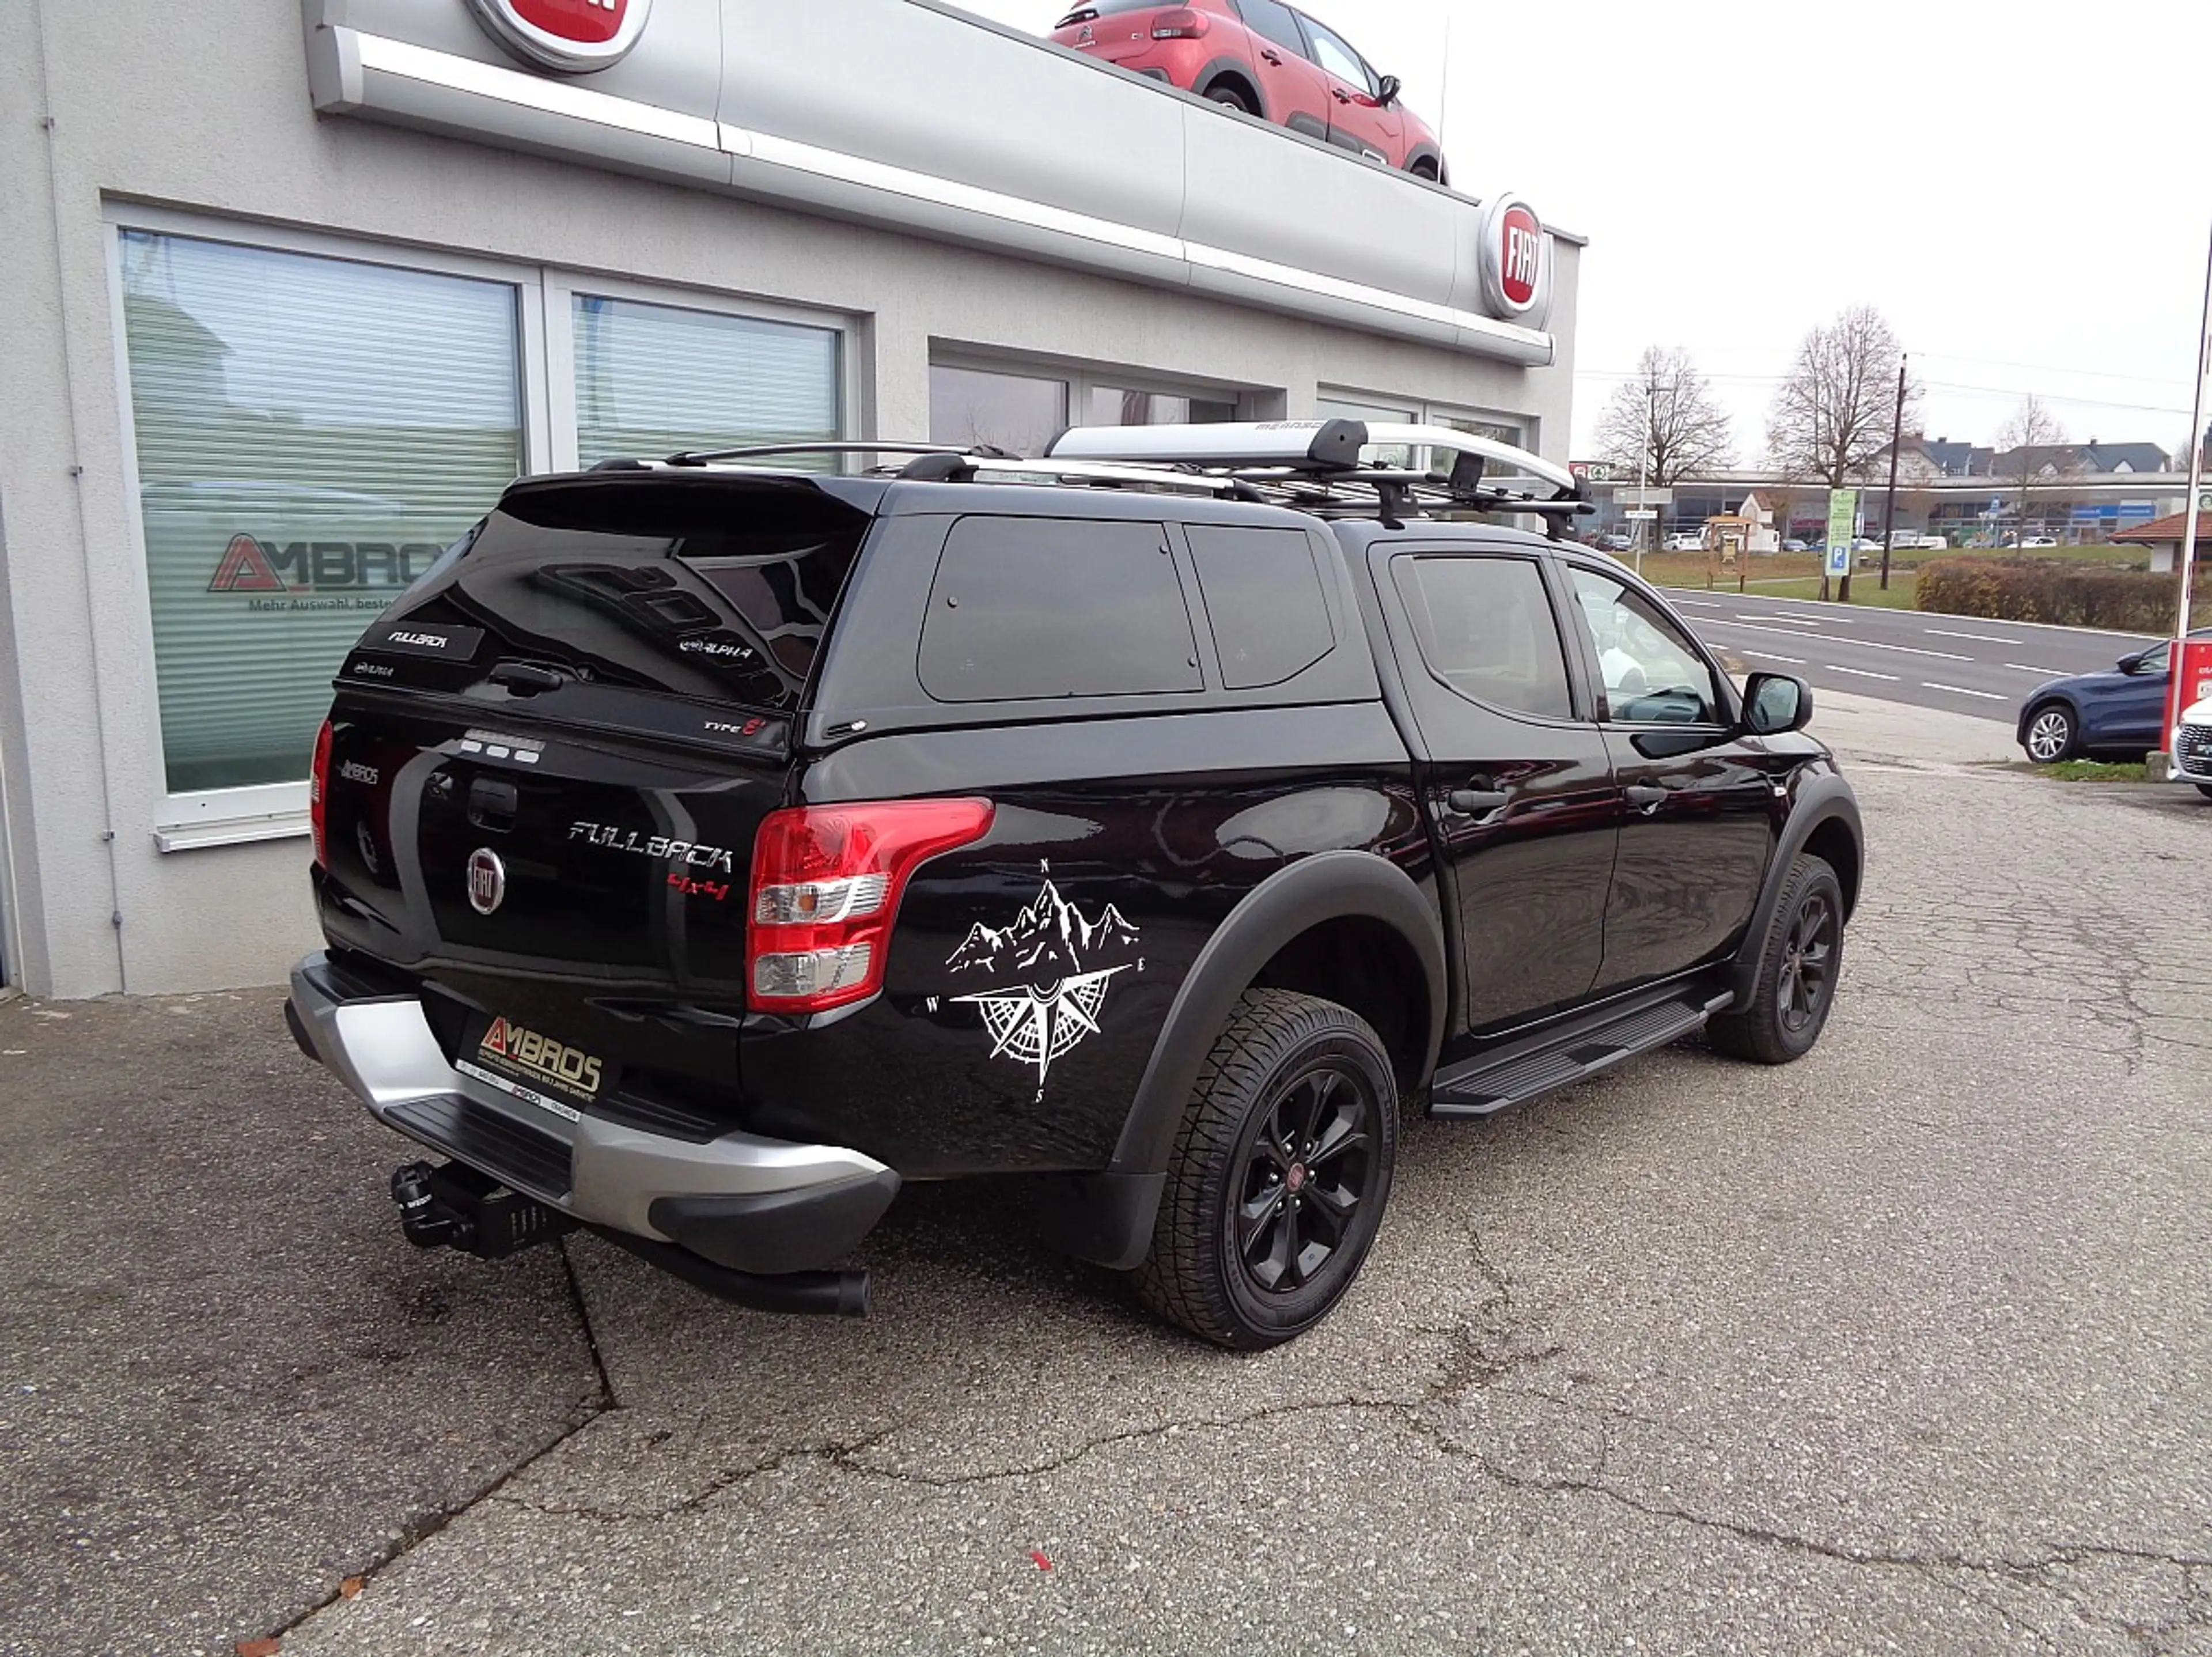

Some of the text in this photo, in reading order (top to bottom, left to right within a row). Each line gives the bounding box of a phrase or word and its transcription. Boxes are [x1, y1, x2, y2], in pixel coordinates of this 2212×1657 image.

[1506, 226, 1539, 287] FIAT
[207, 532, 448, 592] AMBRO
[249, 599, 288, 611] Mehr
[291, 599, 352, 611] Auswahl,
[567, 821, 733, 873] FULLBACK
[1040, 858, 1049, 872] N
[474, 866, 495, 898] FIAT
[667, 873, 729, 901] 4x4
[926, 995, 940, 1013] W
[480, 1015, 603, 1093] AMBROS
